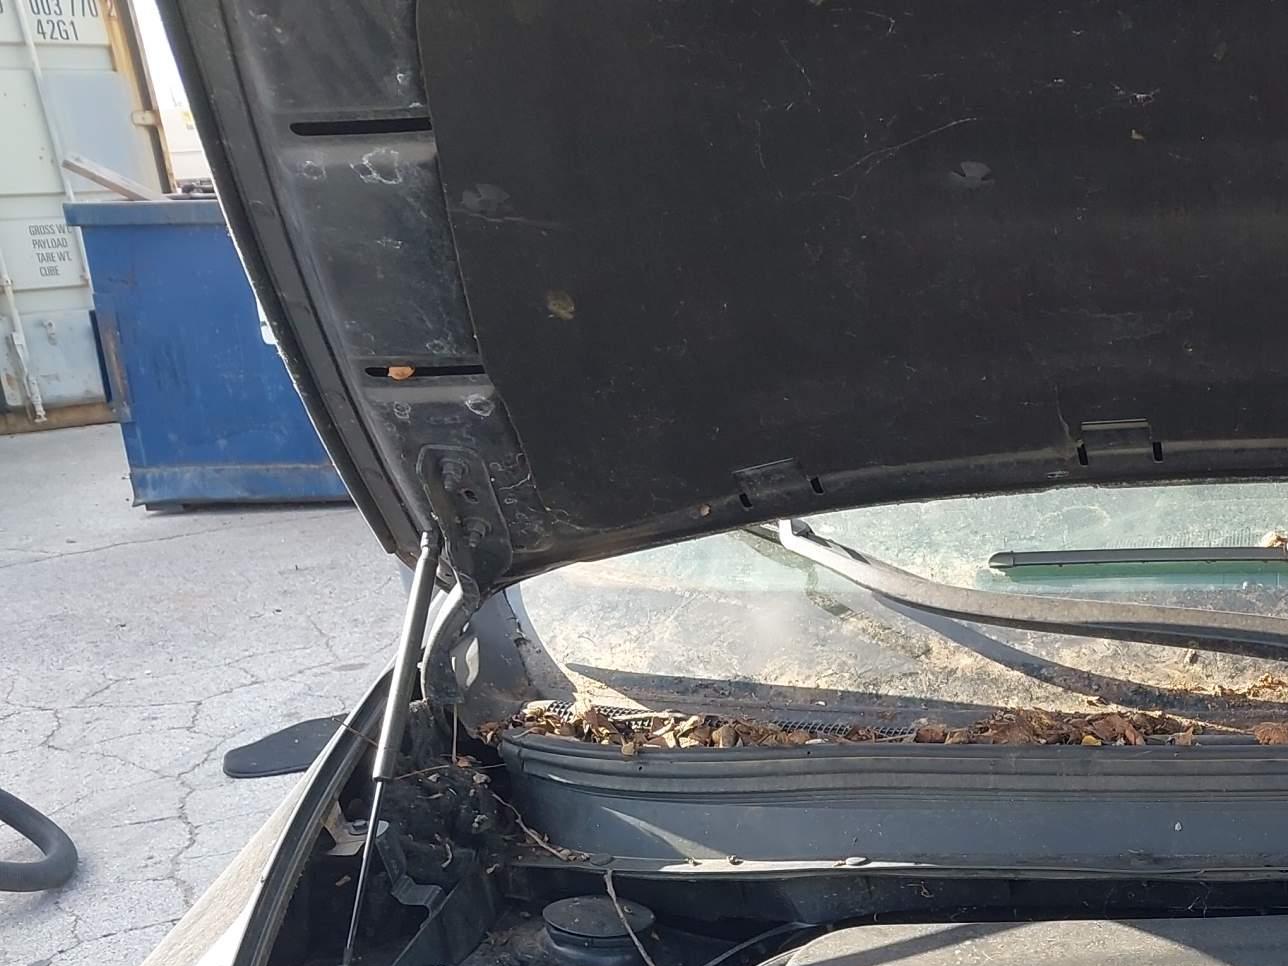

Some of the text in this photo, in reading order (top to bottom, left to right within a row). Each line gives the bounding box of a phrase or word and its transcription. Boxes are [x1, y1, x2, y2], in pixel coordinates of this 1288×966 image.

[36, 19, 79, 40] 42G1
[29, 224, 55, 236] GROSS
[32, 235, 68, 249] PAYLOAD
[36, 252, 56, 263] TARE
[39, 265, 60, 277] CUBE
